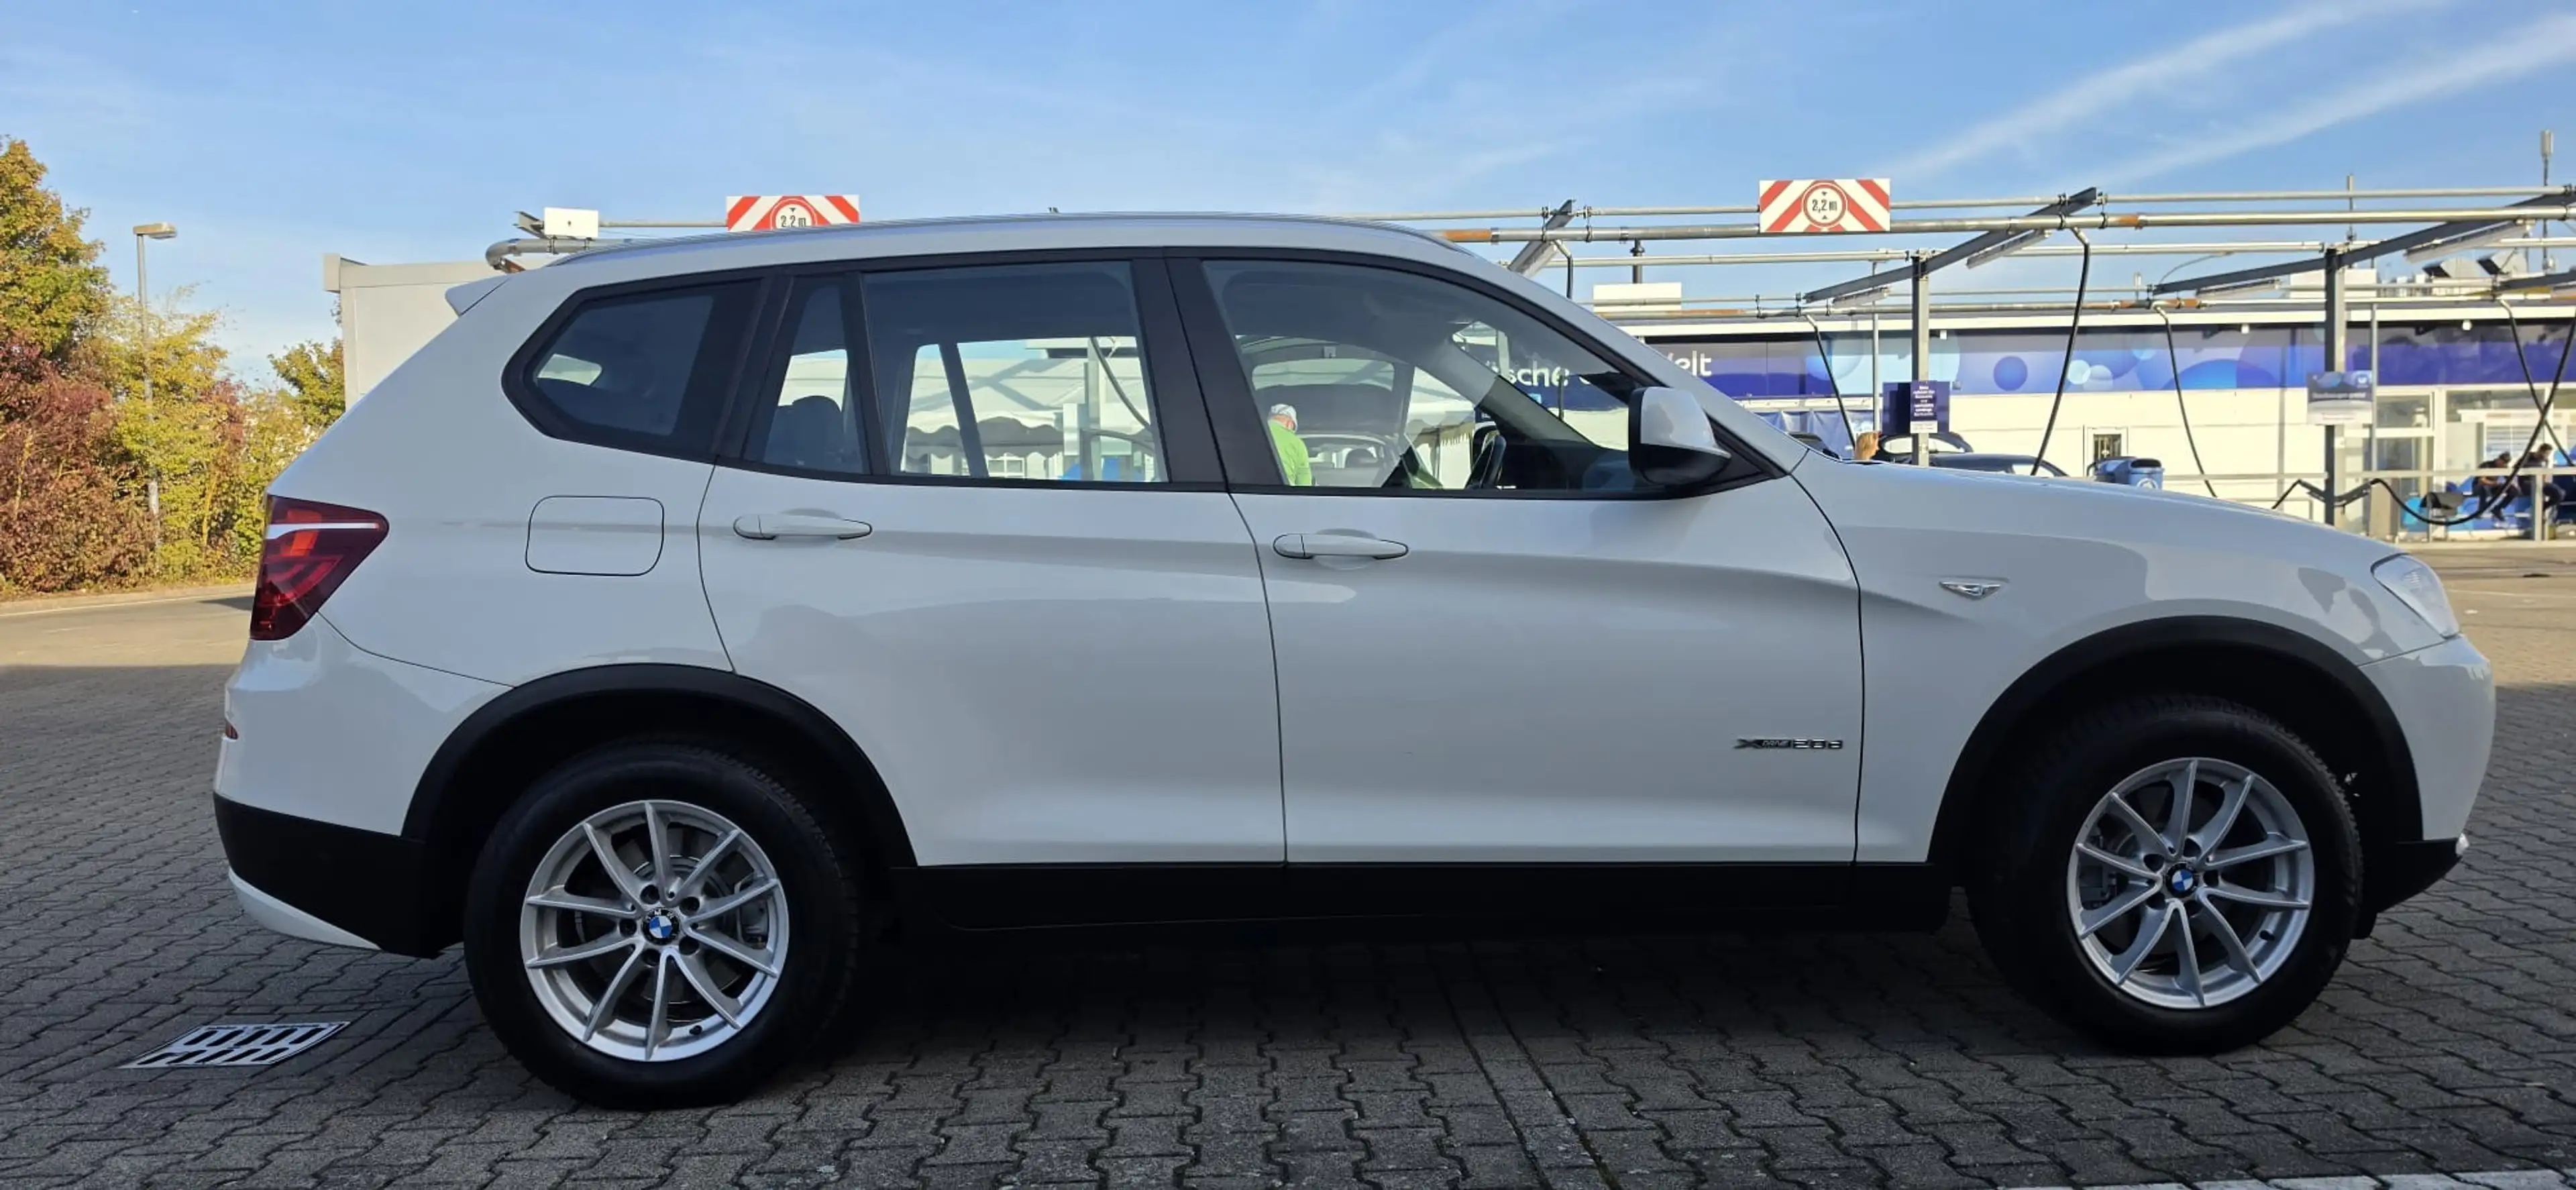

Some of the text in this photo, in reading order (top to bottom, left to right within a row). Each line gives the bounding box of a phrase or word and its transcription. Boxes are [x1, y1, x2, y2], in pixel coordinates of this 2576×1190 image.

[1812, 199, 1827, 213] 2,2
[1485, 350, 1712, 388] sche elt
